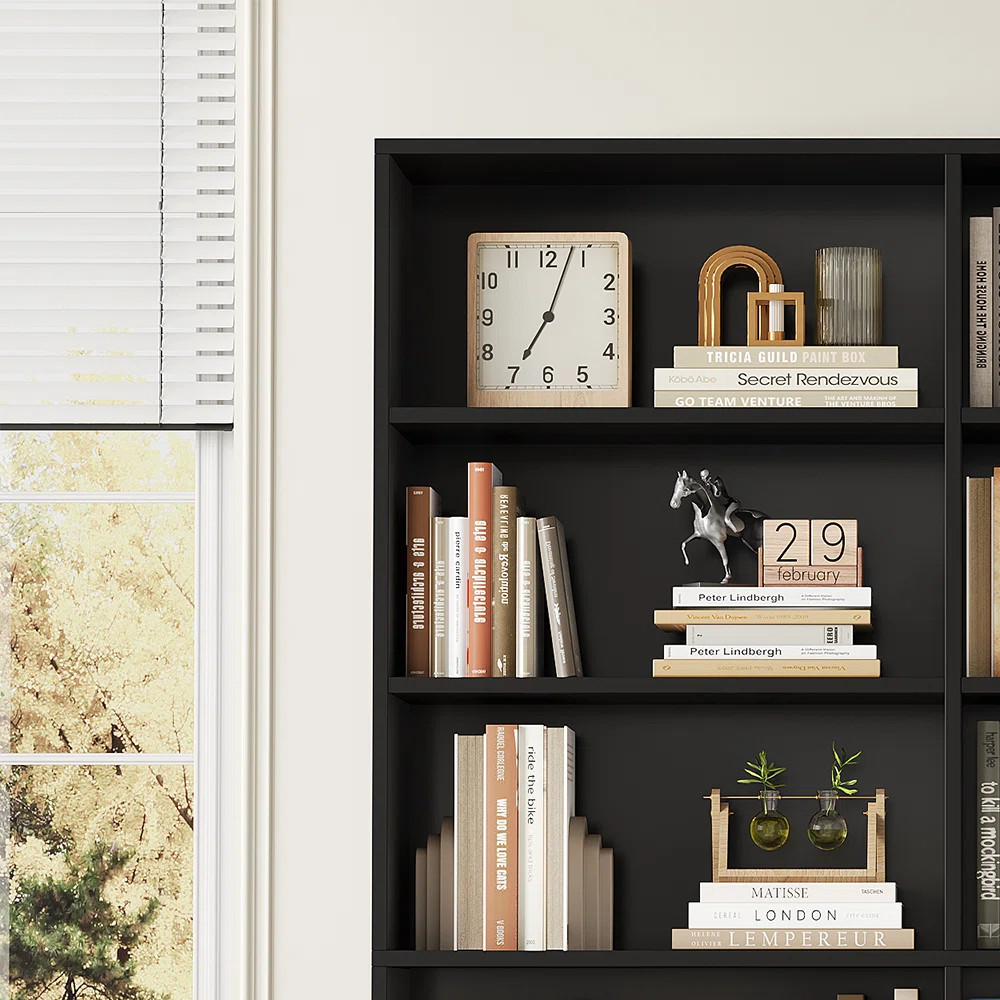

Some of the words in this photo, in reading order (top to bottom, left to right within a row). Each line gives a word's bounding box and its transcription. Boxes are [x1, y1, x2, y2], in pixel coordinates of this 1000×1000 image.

[538, 251, 558, 268] 12
[481, 273, 498, 290] 10
[603, 273, 616, 291] 2
[481, 309, 494, 326] 9
[603, 309, 616, 326] 3
[481, 343, 494, 361] 8
[602, 343, 616, 360] 4
[707, 351, 751, 363] TRICIA
[758, 351, 797, 363] GUILD
[802, 351, 838, 363] PAINT
[842, 351, 866, 363] BOX
[507, 366, 520, 384] 7
[542, 366, 555, 384] 6
[576, 366, 589, 384] 5
[737, 372, 791, 386] Secret
[796, 372, 899, 386] Rendezvous
[675, 396, 695, 407] GO
[699, 396, 737, 407] TEAM
[740, 396, 802, 407] VENTURE
[775, 523, 798, 562] 2
[822, 522, 845, 562] 9
[777, 566, 841, 584] february
[699, 593, 728, 602] Peter
[729, 593, 785, 604] Lindbergh
[826, 627, 834, 644] EERO
[690, 647, 721, 656] Peter
[723, 647, 782, 657] Lindbergh
[527, 746, 536, 771] ride
[527, 774, 536, 794] the
[981, 781, 999, 794] to
[496, 798, 507, 818] WHY
[527, 798, 536, 825] bike
[981, 797, 1000, 812] kill
[496, 819, 507, 831] DO
[981, 816, 995, 824] a
[496, 832, 507, 846] WE
[496, 847, 507, 868] LOVE
[976, 827, 1000, 901] mockingbird
[496, 869, 507, 891] CATS
[751, 887, 809, 899] MATISSE
[755, 910, 837, 921] LONDON
[729, 931, 887, 947] LEMPEREUR
